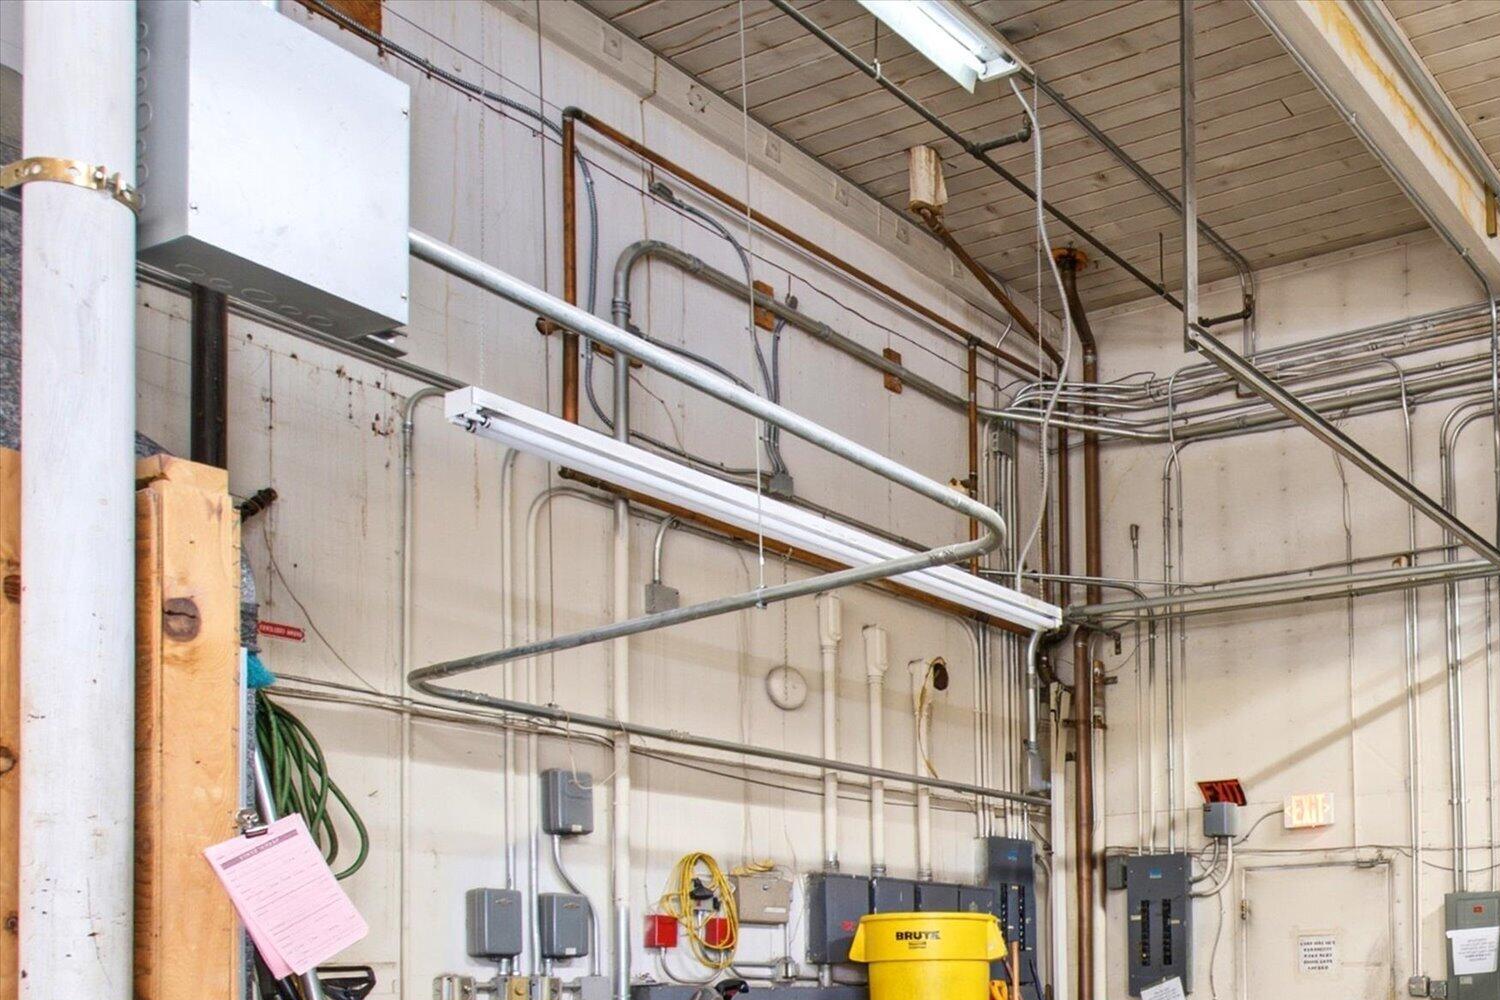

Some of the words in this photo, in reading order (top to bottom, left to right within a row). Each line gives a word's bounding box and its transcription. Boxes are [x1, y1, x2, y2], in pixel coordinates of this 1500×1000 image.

[1199, 781, 1243, 805] EXIT
[1291, 793, 1325, 825] EXIT
[896, 930, 941, 941] BRUTE
